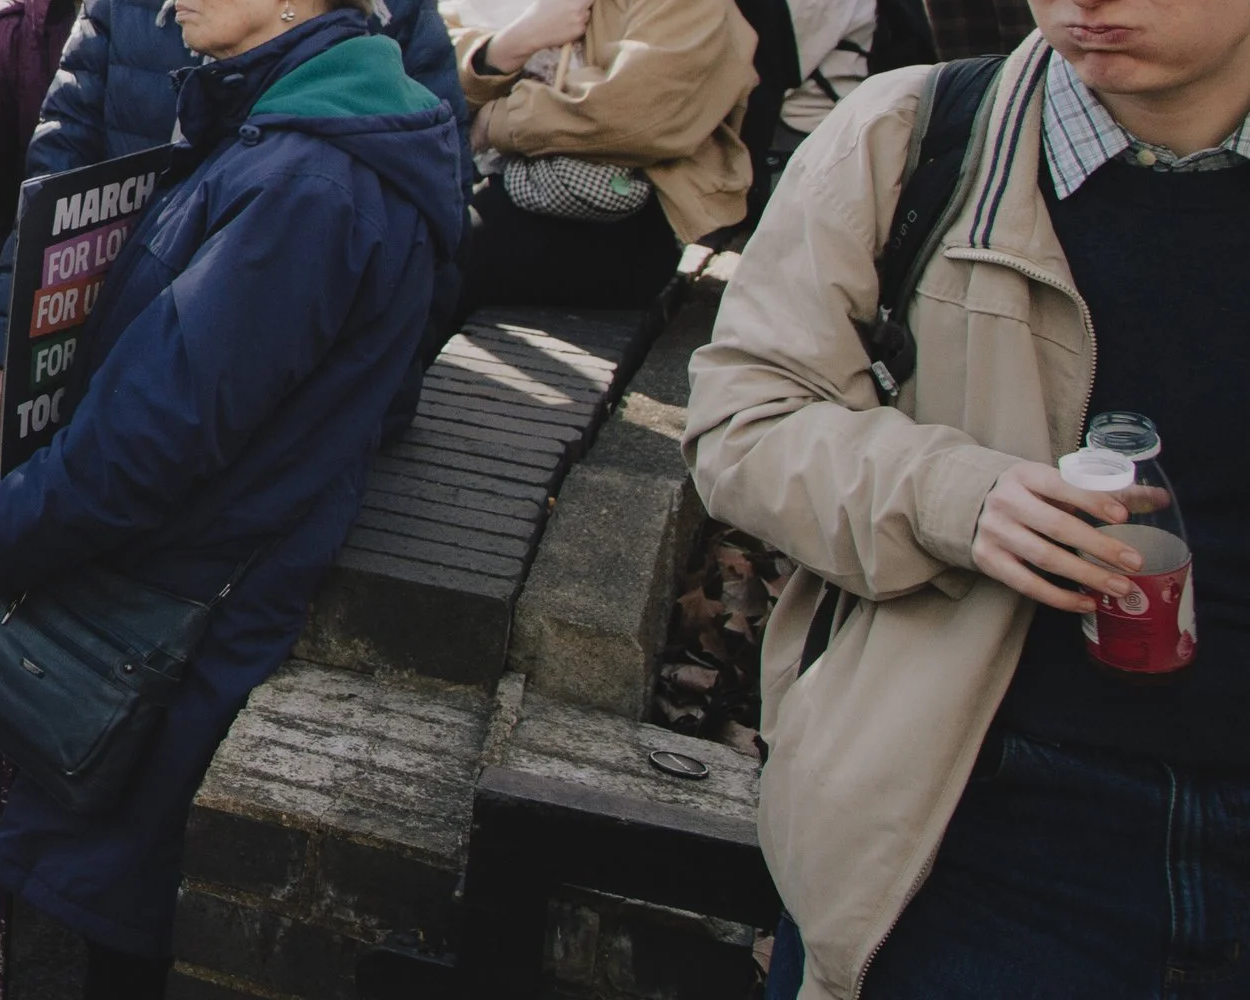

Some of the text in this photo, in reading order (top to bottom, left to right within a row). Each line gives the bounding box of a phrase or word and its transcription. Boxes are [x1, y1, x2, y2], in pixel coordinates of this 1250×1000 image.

[52, 171, 156, 237] MARCH
[46, 240, 90, 286] FOR
[35, 287, 79, 330] FOR
[35, 337, 77, 383] FOR
